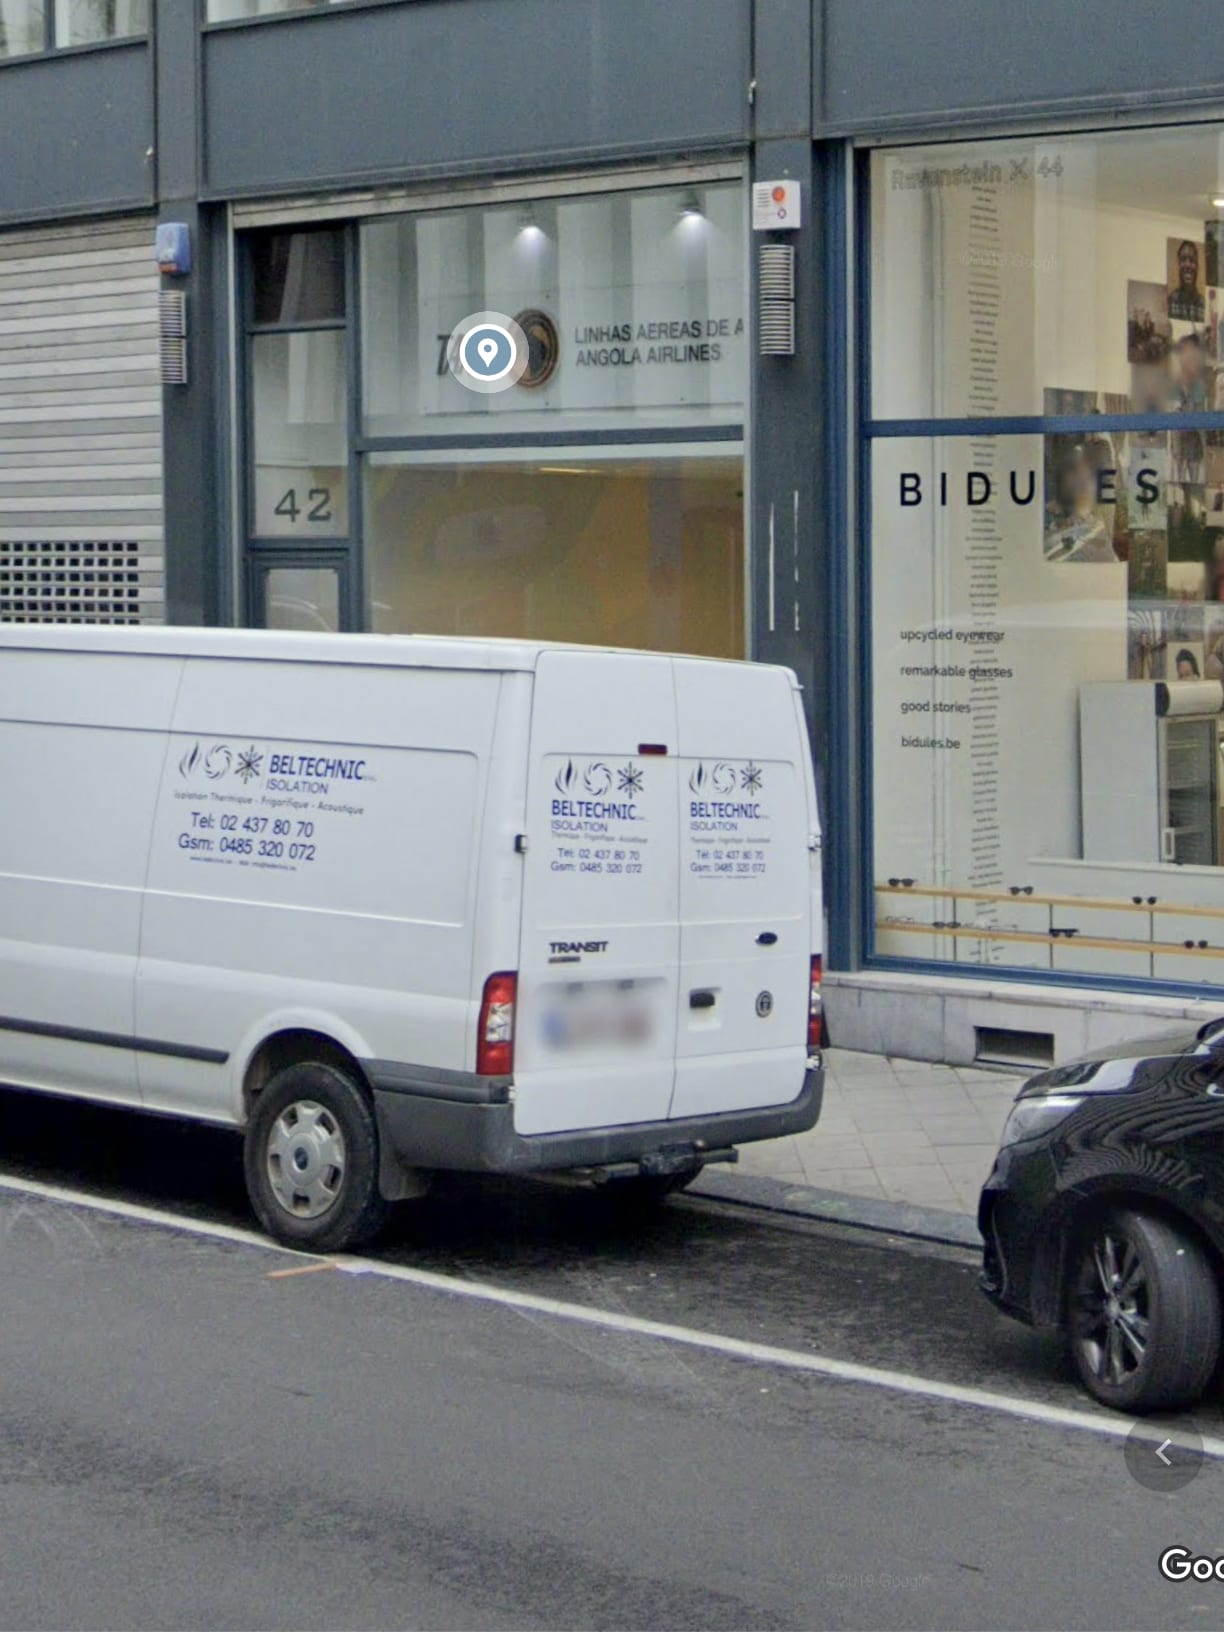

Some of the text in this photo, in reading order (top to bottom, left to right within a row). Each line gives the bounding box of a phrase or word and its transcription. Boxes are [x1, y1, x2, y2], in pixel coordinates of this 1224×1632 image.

[1037, 154, 1064, 180] 44
[574, 323, 633, 344] LINHAS
[636, 320, 702, 341] AEREAS
[706, 318, 730, 337] DE
[575, 343, 722, 367] ANGOLA AIRLINES
[899, 468, 1161, 507] BIDUES
[273, 487, 333, 524] 42
[900, 627, 1006, 646] upcycled eyewear
[900, 663, 1013, 682] remarkable glasses
[901, 699, 971, 715] good stories
[901, 735, 961, 751] bidules.be
[268, 754, 366, 781] BELTECHNIC
[266, 777, 329, 795] ISOLATION
[551, 799, 637, 820] BELTECHNIC
[690, 801, 761, 819] BELTECHNIC
[191, 811, 314, 838] Tel: 02 437 80 70
[551, 819, 608, 833] ISOLATION
[689, 820, 738, 832] ISOLATION
[178, 832, 316, 861] Gsm: 0485 320 072
[579, 848, 591, 859] 02
[594, 849, 611, 860] 437
[614, 850, 625, 861] 80
[629, 850, 641, 861] 70
[579, 862, 602, 873] 0485
[606, 863, 623, 874] 320
[625, 863, 643, 874] 072
[548, 940, 610, 955] TRANSIT
